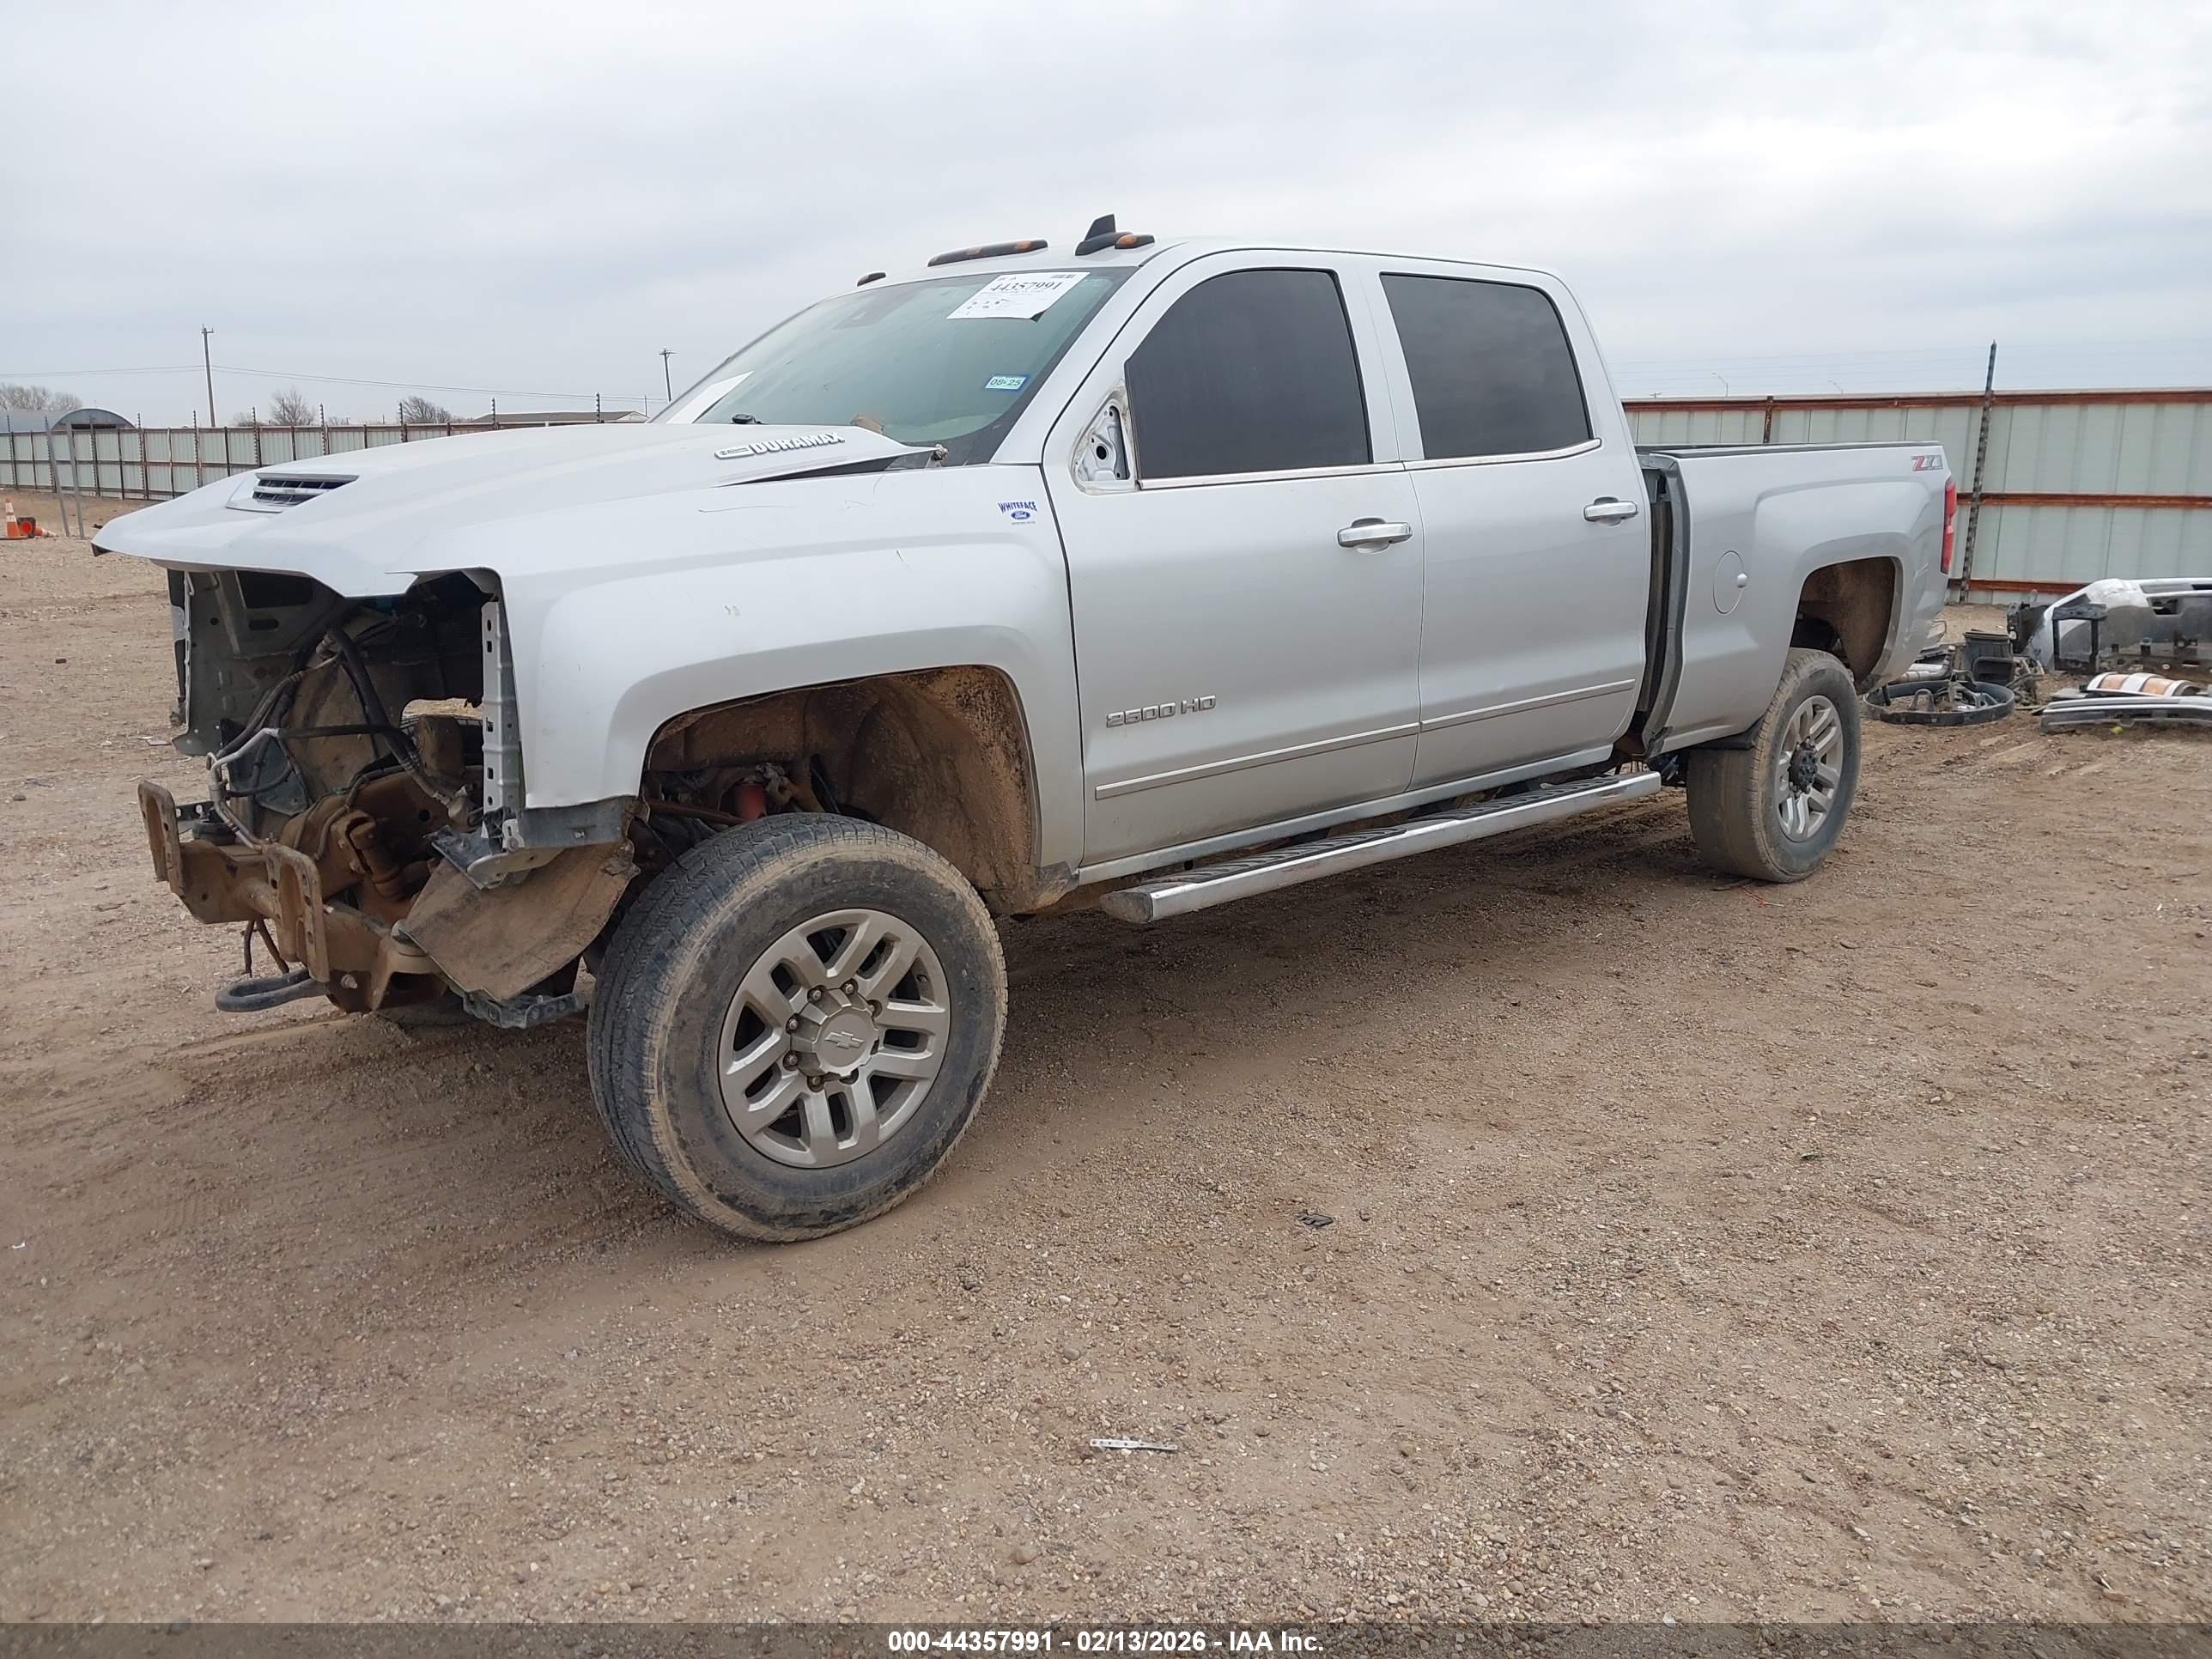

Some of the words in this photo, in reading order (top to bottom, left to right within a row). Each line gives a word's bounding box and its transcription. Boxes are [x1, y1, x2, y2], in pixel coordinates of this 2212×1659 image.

[748, 432, 846, 455] DURAMAX
[1106, 702, 1176, 728] 2500
[1181, 695, 1217, 714] HD
